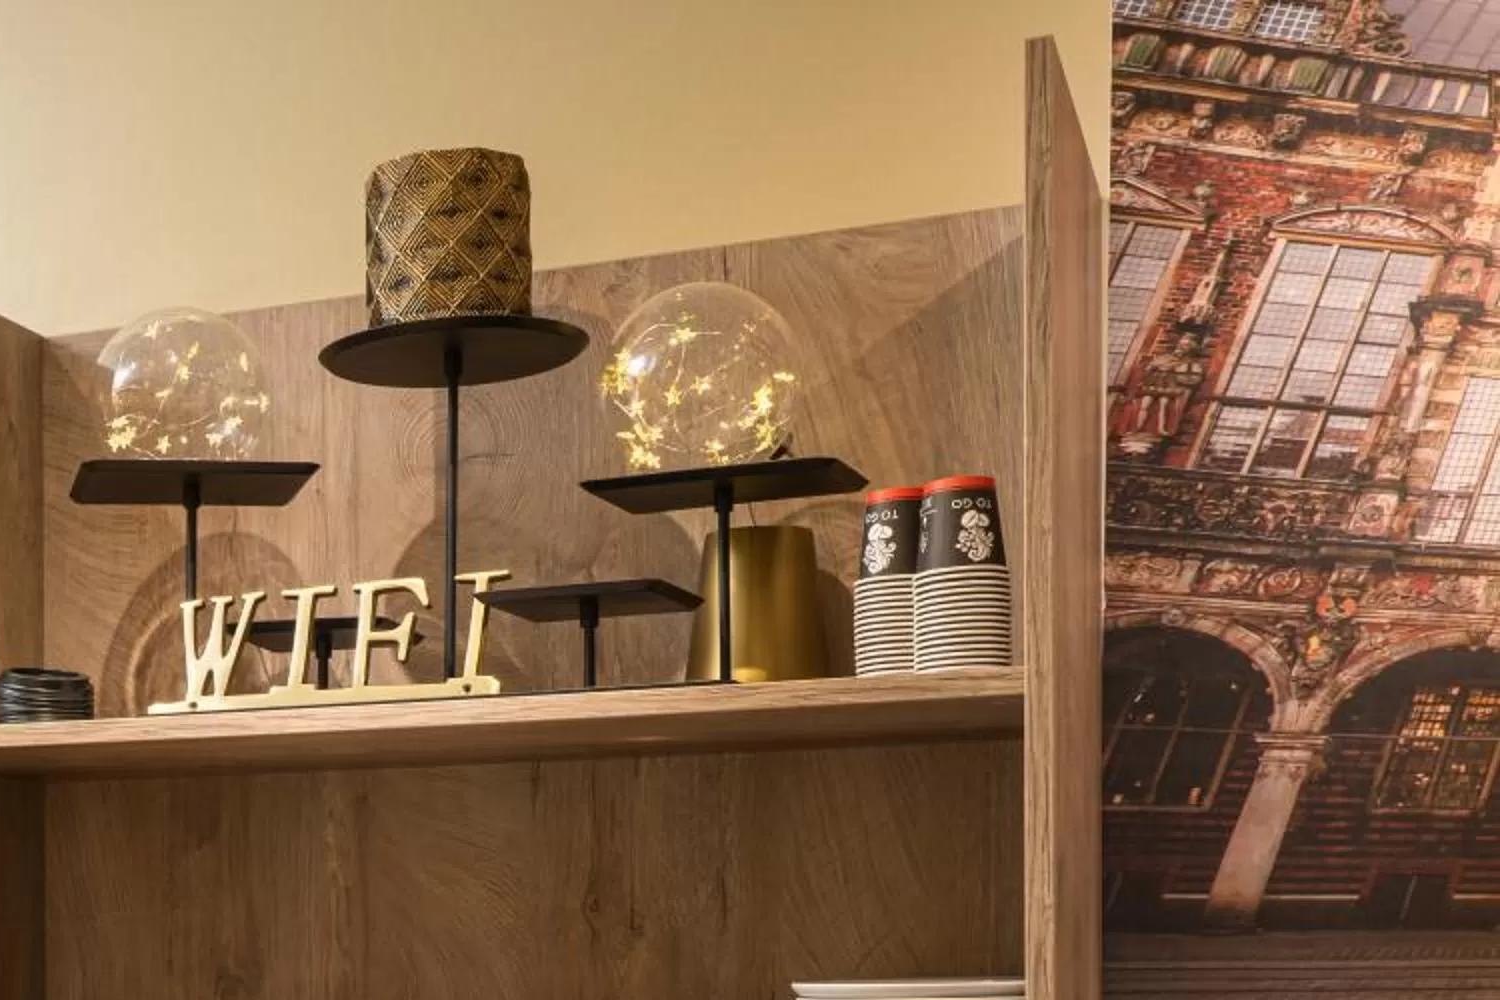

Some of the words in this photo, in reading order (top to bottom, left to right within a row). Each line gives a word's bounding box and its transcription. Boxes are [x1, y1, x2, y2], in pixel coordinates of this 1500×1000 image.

[951, 498, 973, 509] GO
[881, 509, 899, 521] TO
[180, 570, 511, 700] WIFI
